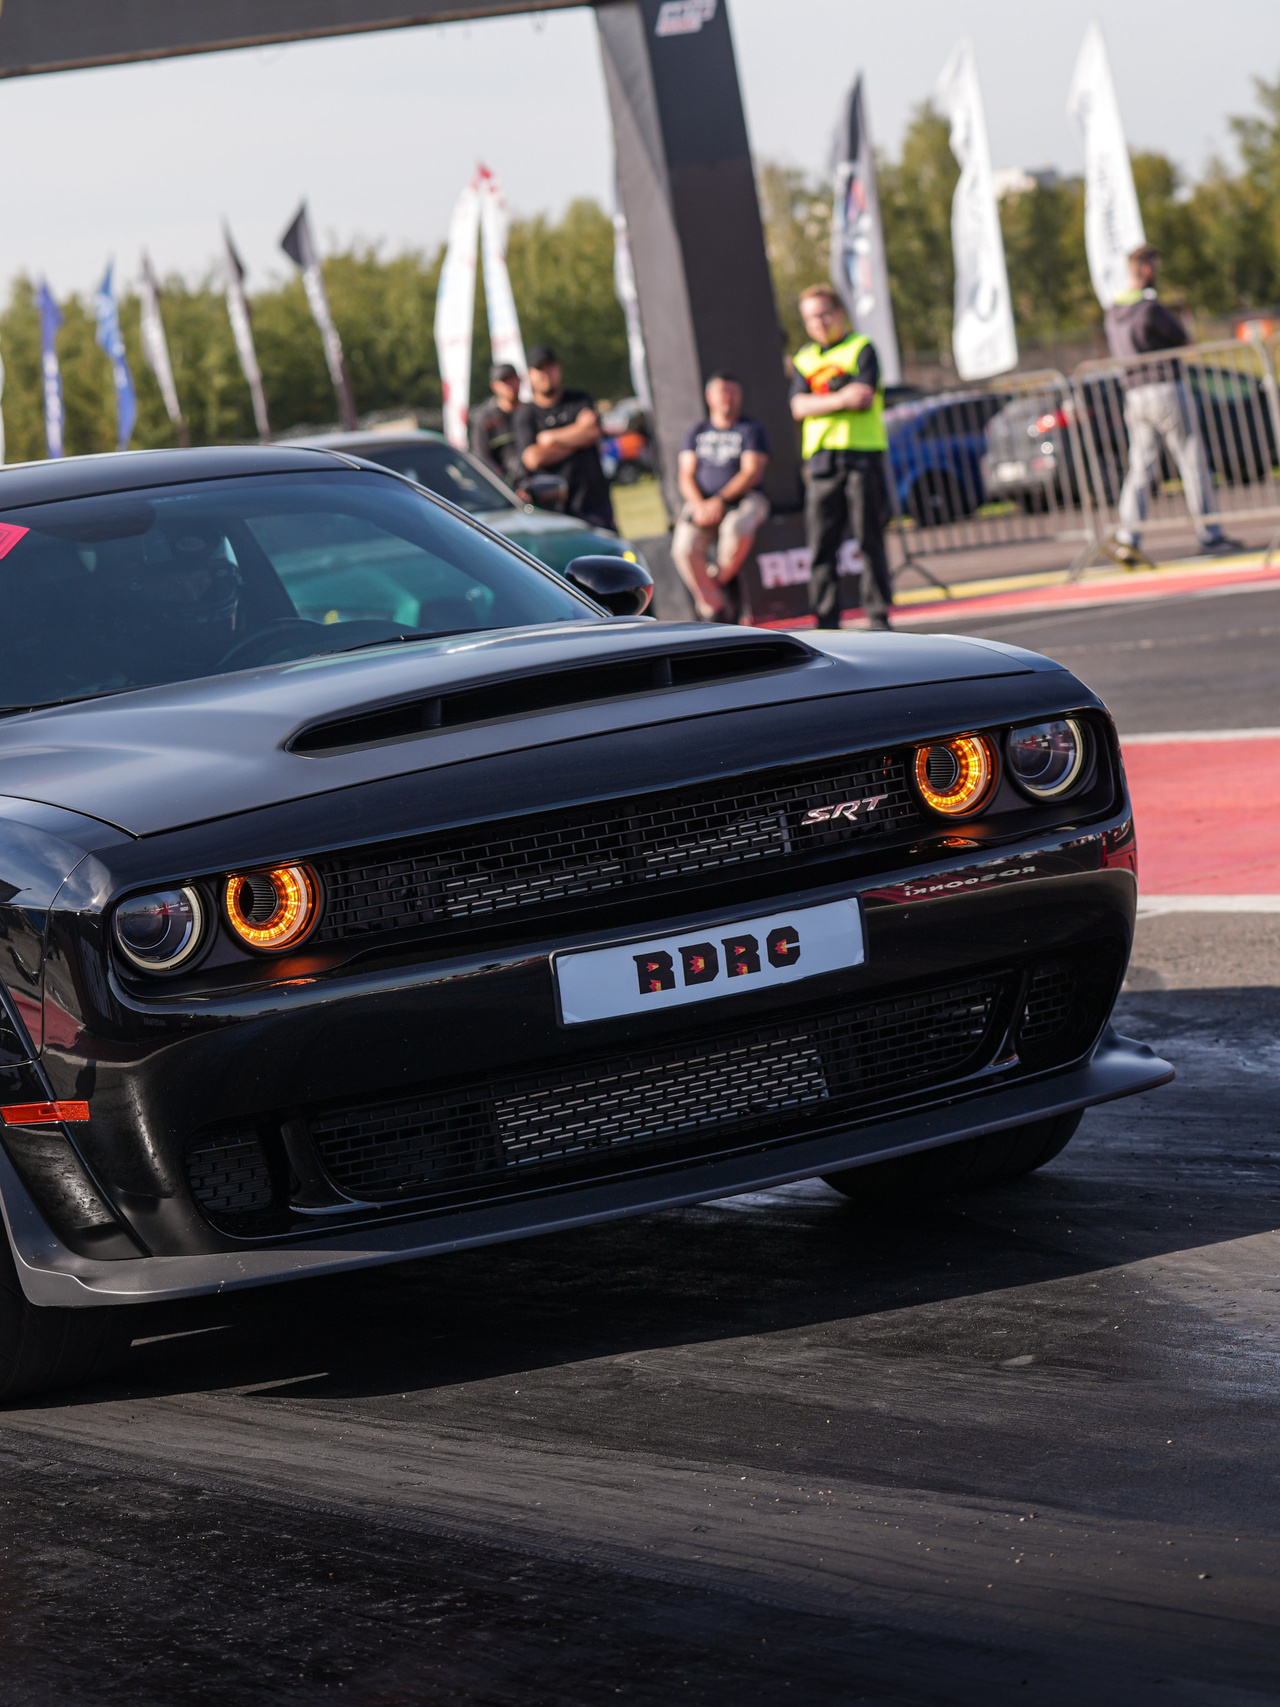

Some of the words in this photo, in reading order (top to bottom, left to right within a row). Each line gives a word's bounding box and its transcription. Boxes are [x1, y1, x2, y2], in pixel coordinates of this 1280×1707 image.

[757, 539, 865, 589] RDC
[801, 794, 889, 825] SRT
[632, 925, 801, 995] RDRC
